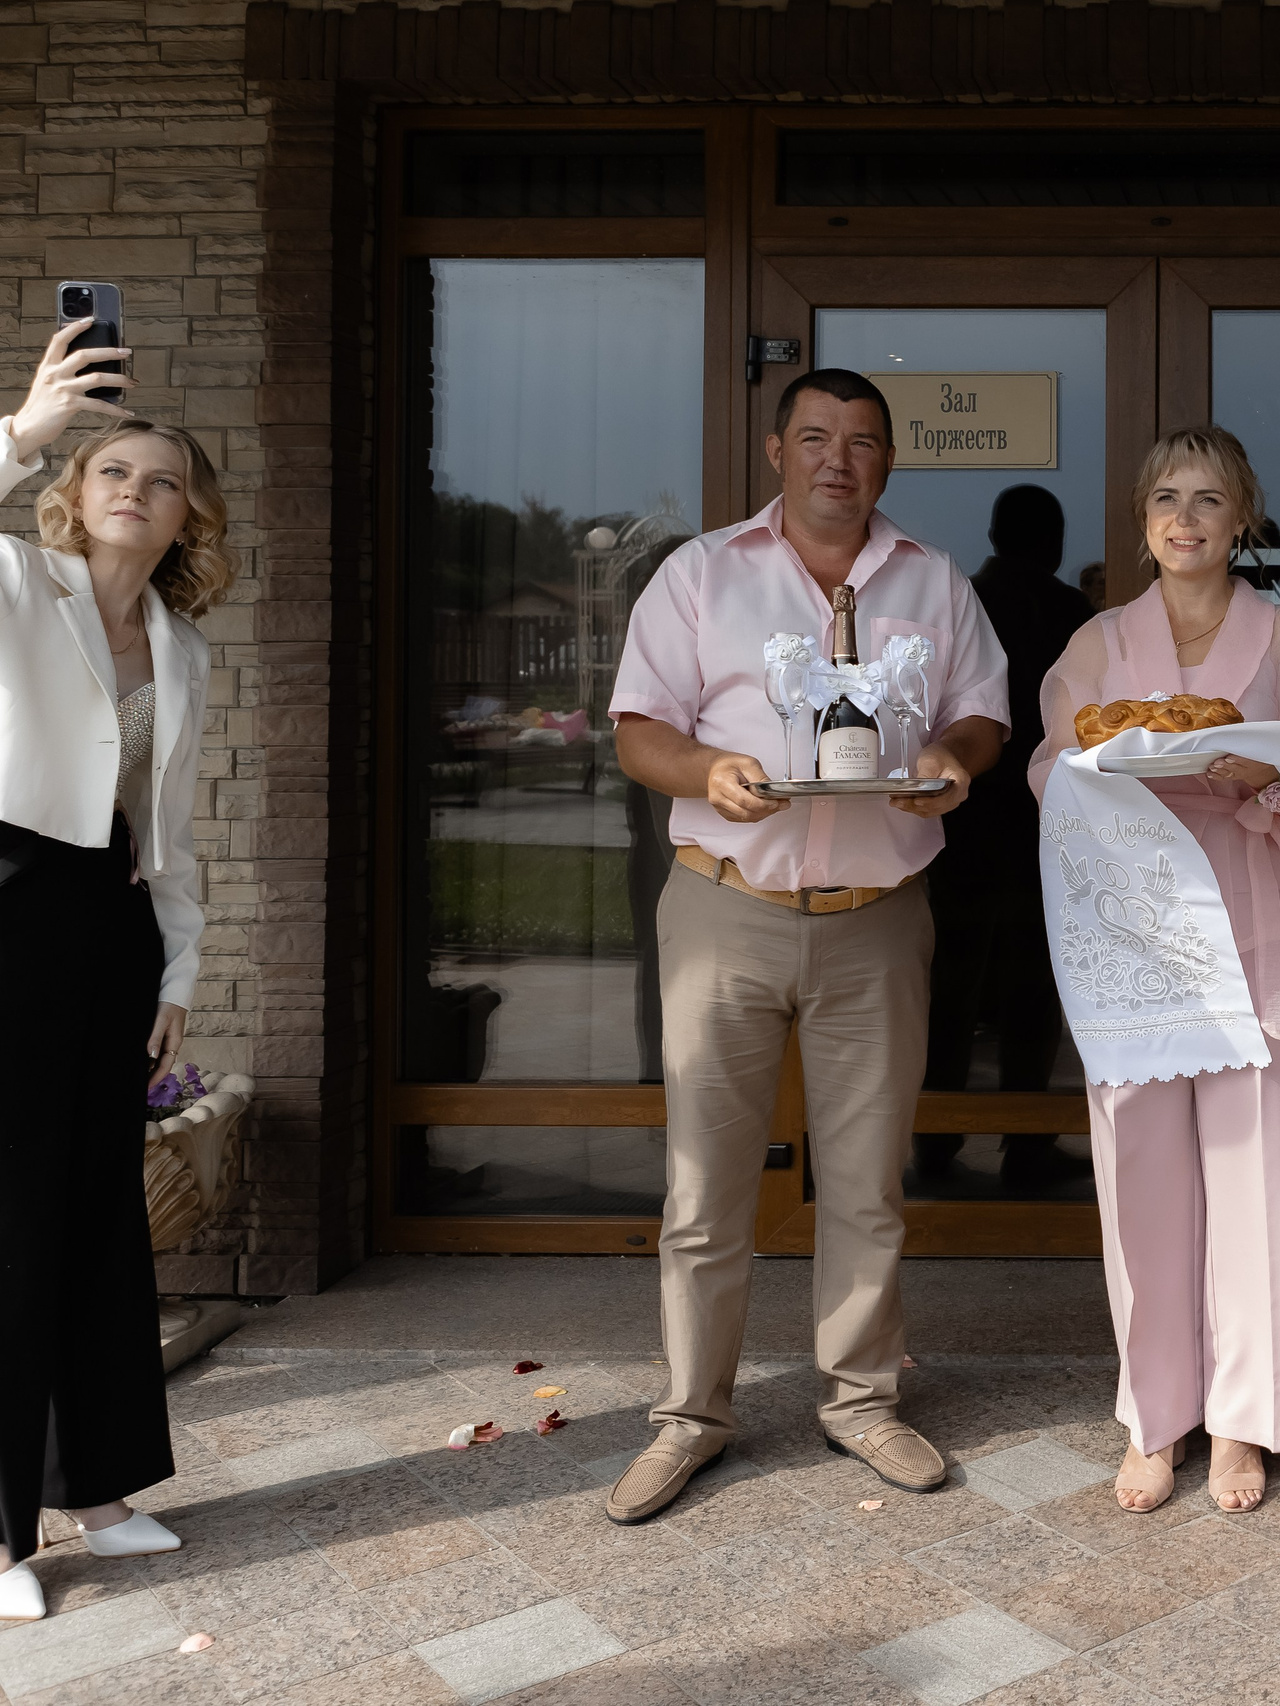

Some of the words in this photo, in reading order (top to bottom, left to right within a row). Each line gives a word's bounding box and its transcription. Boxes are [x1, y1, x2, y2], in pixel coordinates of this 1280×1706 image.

[940, 383, 977, 413] Зал
[910, 421, 1007, 456] Торжеств
[1099, 812, 1177, 848] Любовь
